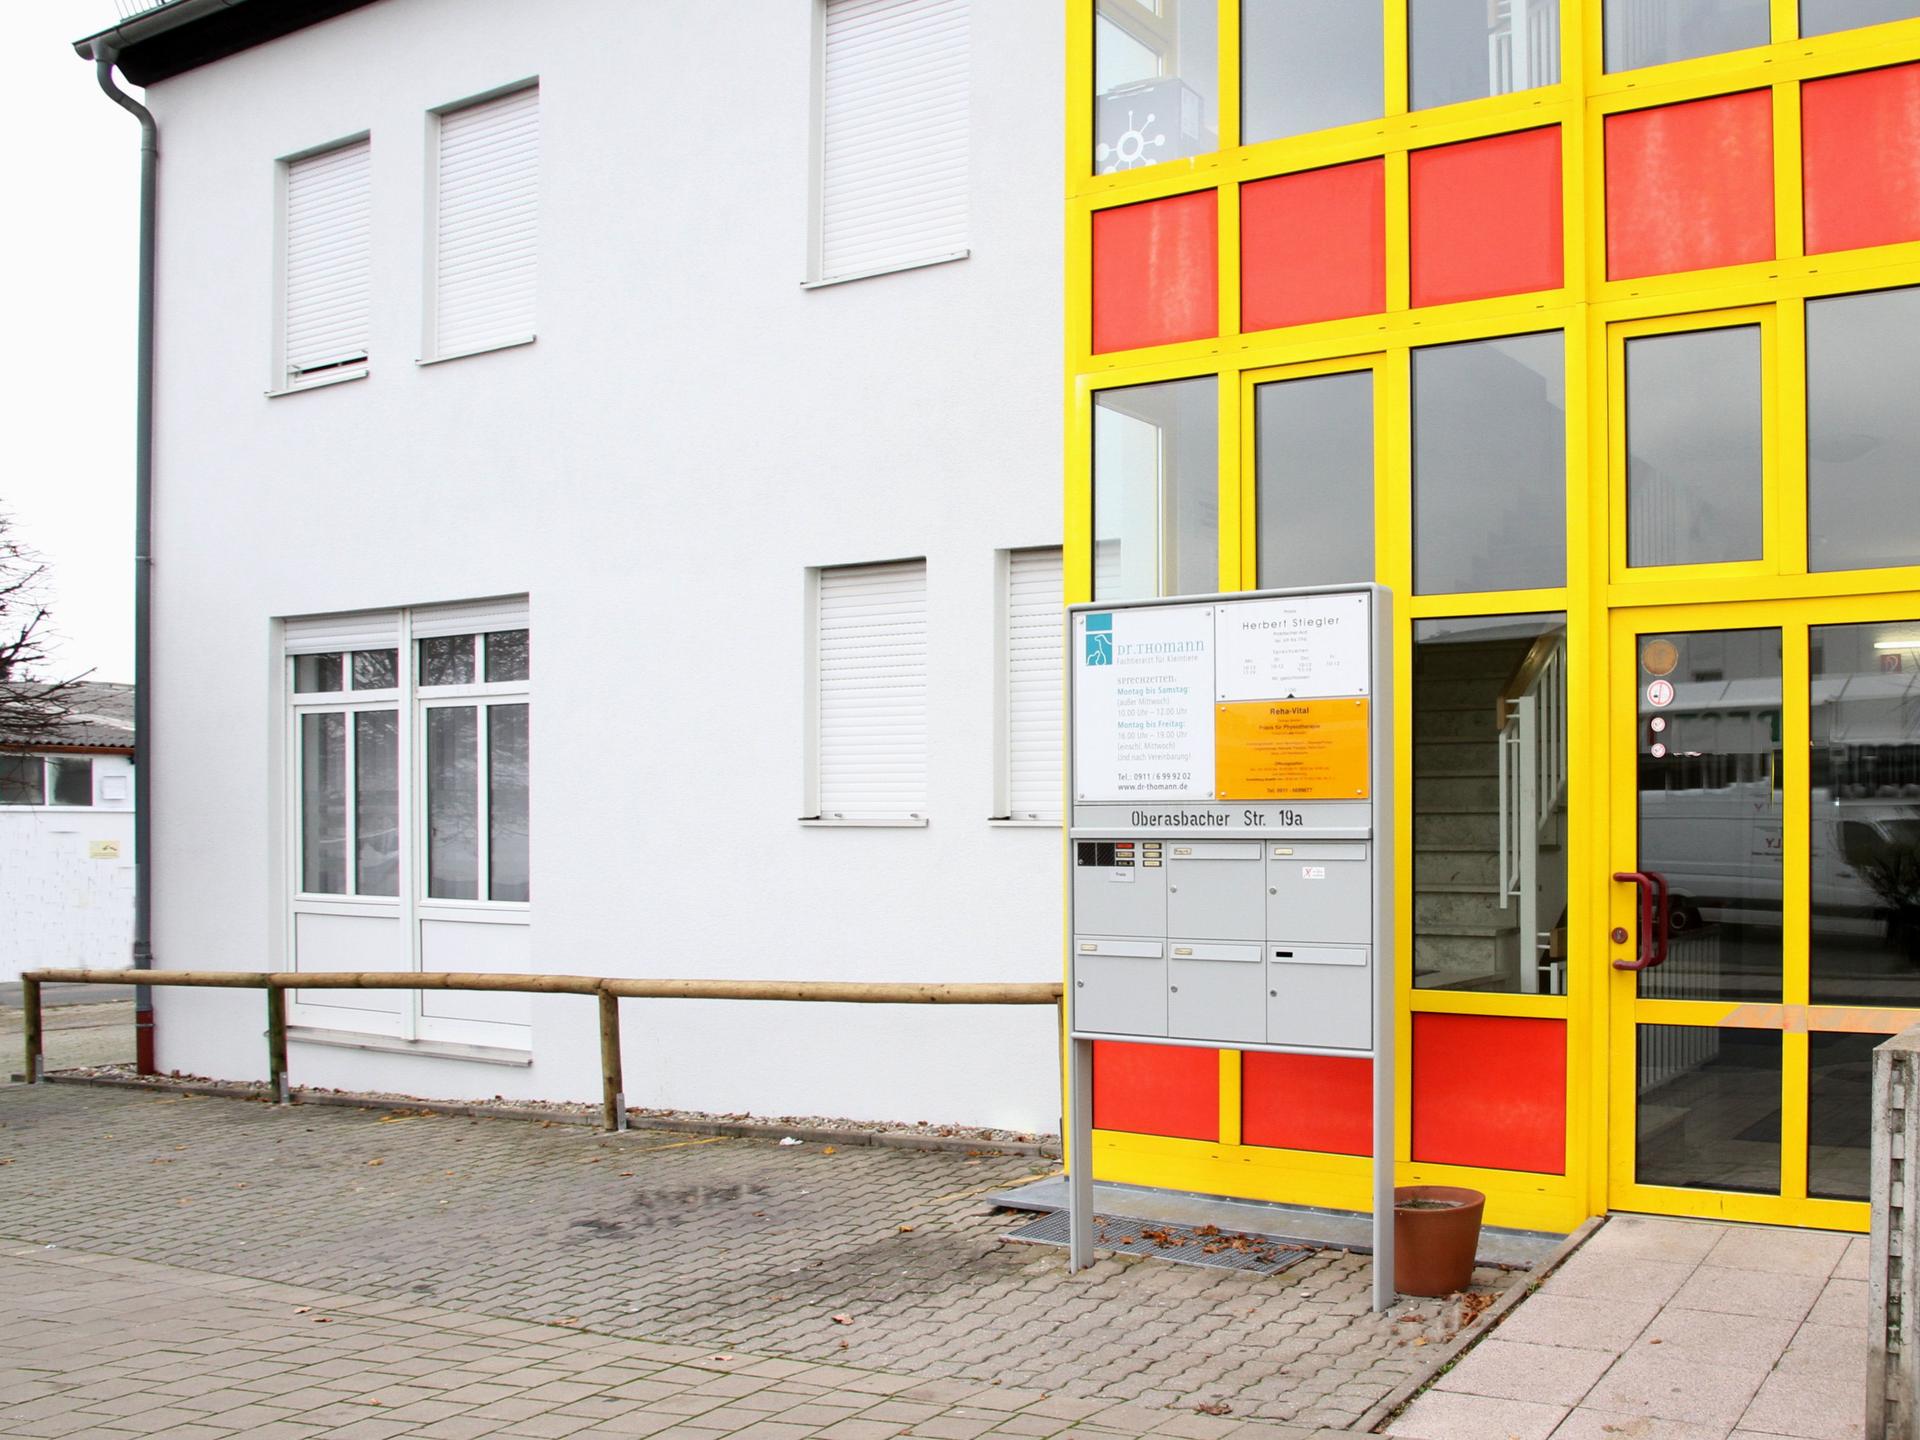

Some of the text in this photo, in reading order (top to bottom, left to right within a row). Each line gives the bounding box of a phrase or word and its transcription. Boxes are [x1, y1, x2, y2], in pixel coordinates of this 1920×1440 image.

[1242, 616, 1339, 631] Herbert Stiegler
[1117, 688, 1144, 697] Montag
[1146, 687, 1156, 695] bis
[1270, 706, 1310, 715] Reha-Vital
[1117, 721, 1144, 730] Montag
[1146, 720, 1156, 728] bis
[1134, 772, 1151, 781] 0911
[1162, 772, 1171, 780] 99
[1172, 772, 1181, 780] 92
[1182, 771, 1191, 780] 02
[1117, 782, 1189, 791] www.dr-thomann.de
[1131, 810, 1304, 827] Oberasbacher Str. 19a
